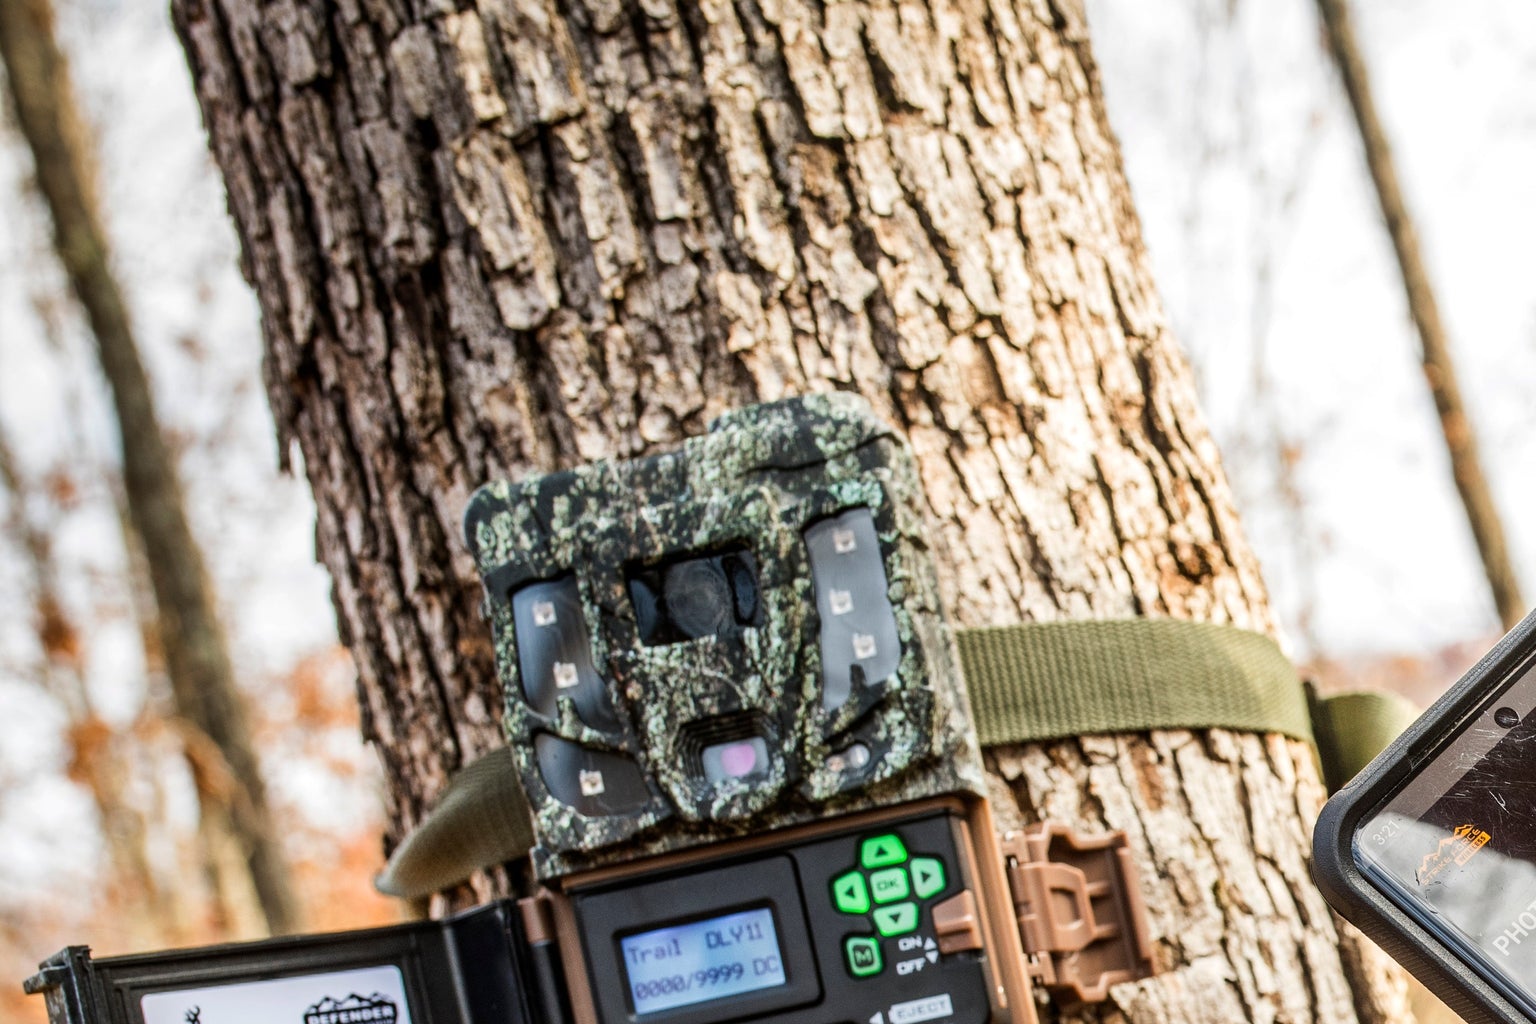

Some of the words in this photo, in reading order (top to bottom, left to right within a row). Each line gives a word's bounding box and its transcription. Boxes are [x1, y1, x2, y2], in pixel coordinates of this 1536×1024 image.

[1372, 819, 1400, 846] 3:21
[877, 878, 898, 891] OK
[628, 938, 683, 965] Trail
[898, 935, 922, 951] ON
[854, 947, 873, 964] M
[896, 957, 926, 975] OFF
[634, 962, 744, 1000] 0000/9999
[752, 955, 779, 976] DC
[896, 1000, 947, 1019] EJECT
